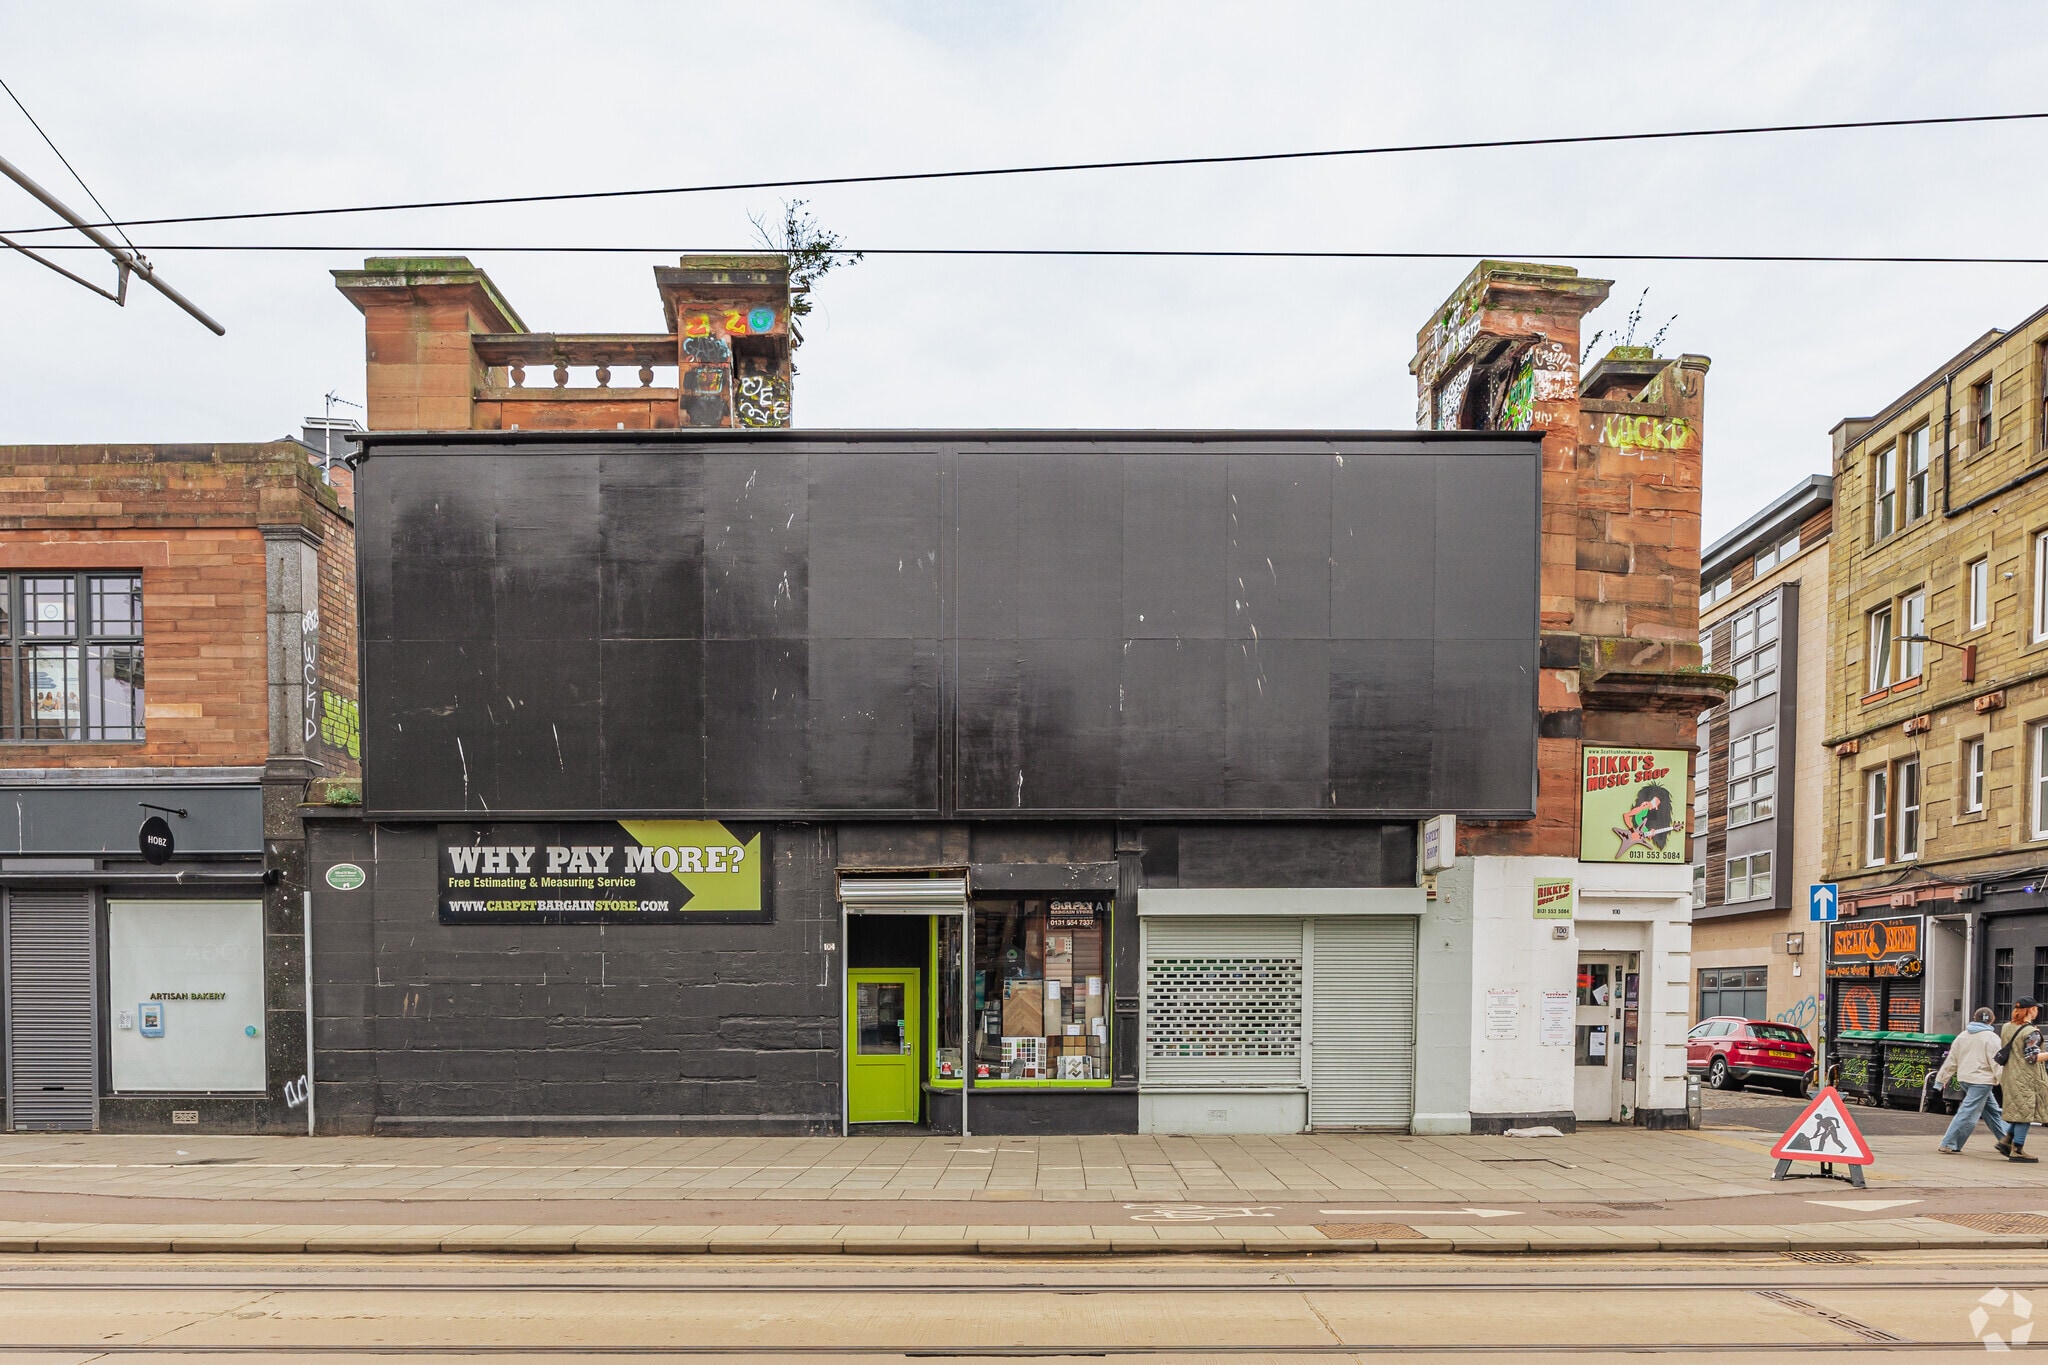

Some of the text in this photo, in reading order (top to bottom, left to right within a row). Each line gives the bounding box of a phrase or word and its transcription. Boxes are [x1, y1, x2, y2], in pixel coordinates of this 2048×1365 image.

[1586, 755, 1655, 776] RIKKI'S
[1586, 768, 1670, 792] MUSIC SHOP
[147, 835, 167, 847] HOBZ
[448, 845, 746, 874] WHY PAY MORE?
[1629, 851, 1681, 860] 0131 553 5084
[448, 876, 636, 890] Free Estimating & Measuring Service
[1537, 884, 1570, 898] RIKKI'S
[448, 900, 669, 912] WWW.CARPETBARGAINSTORE.COM
[149, 992, 226, 1001] ARTISAN BAKERY
